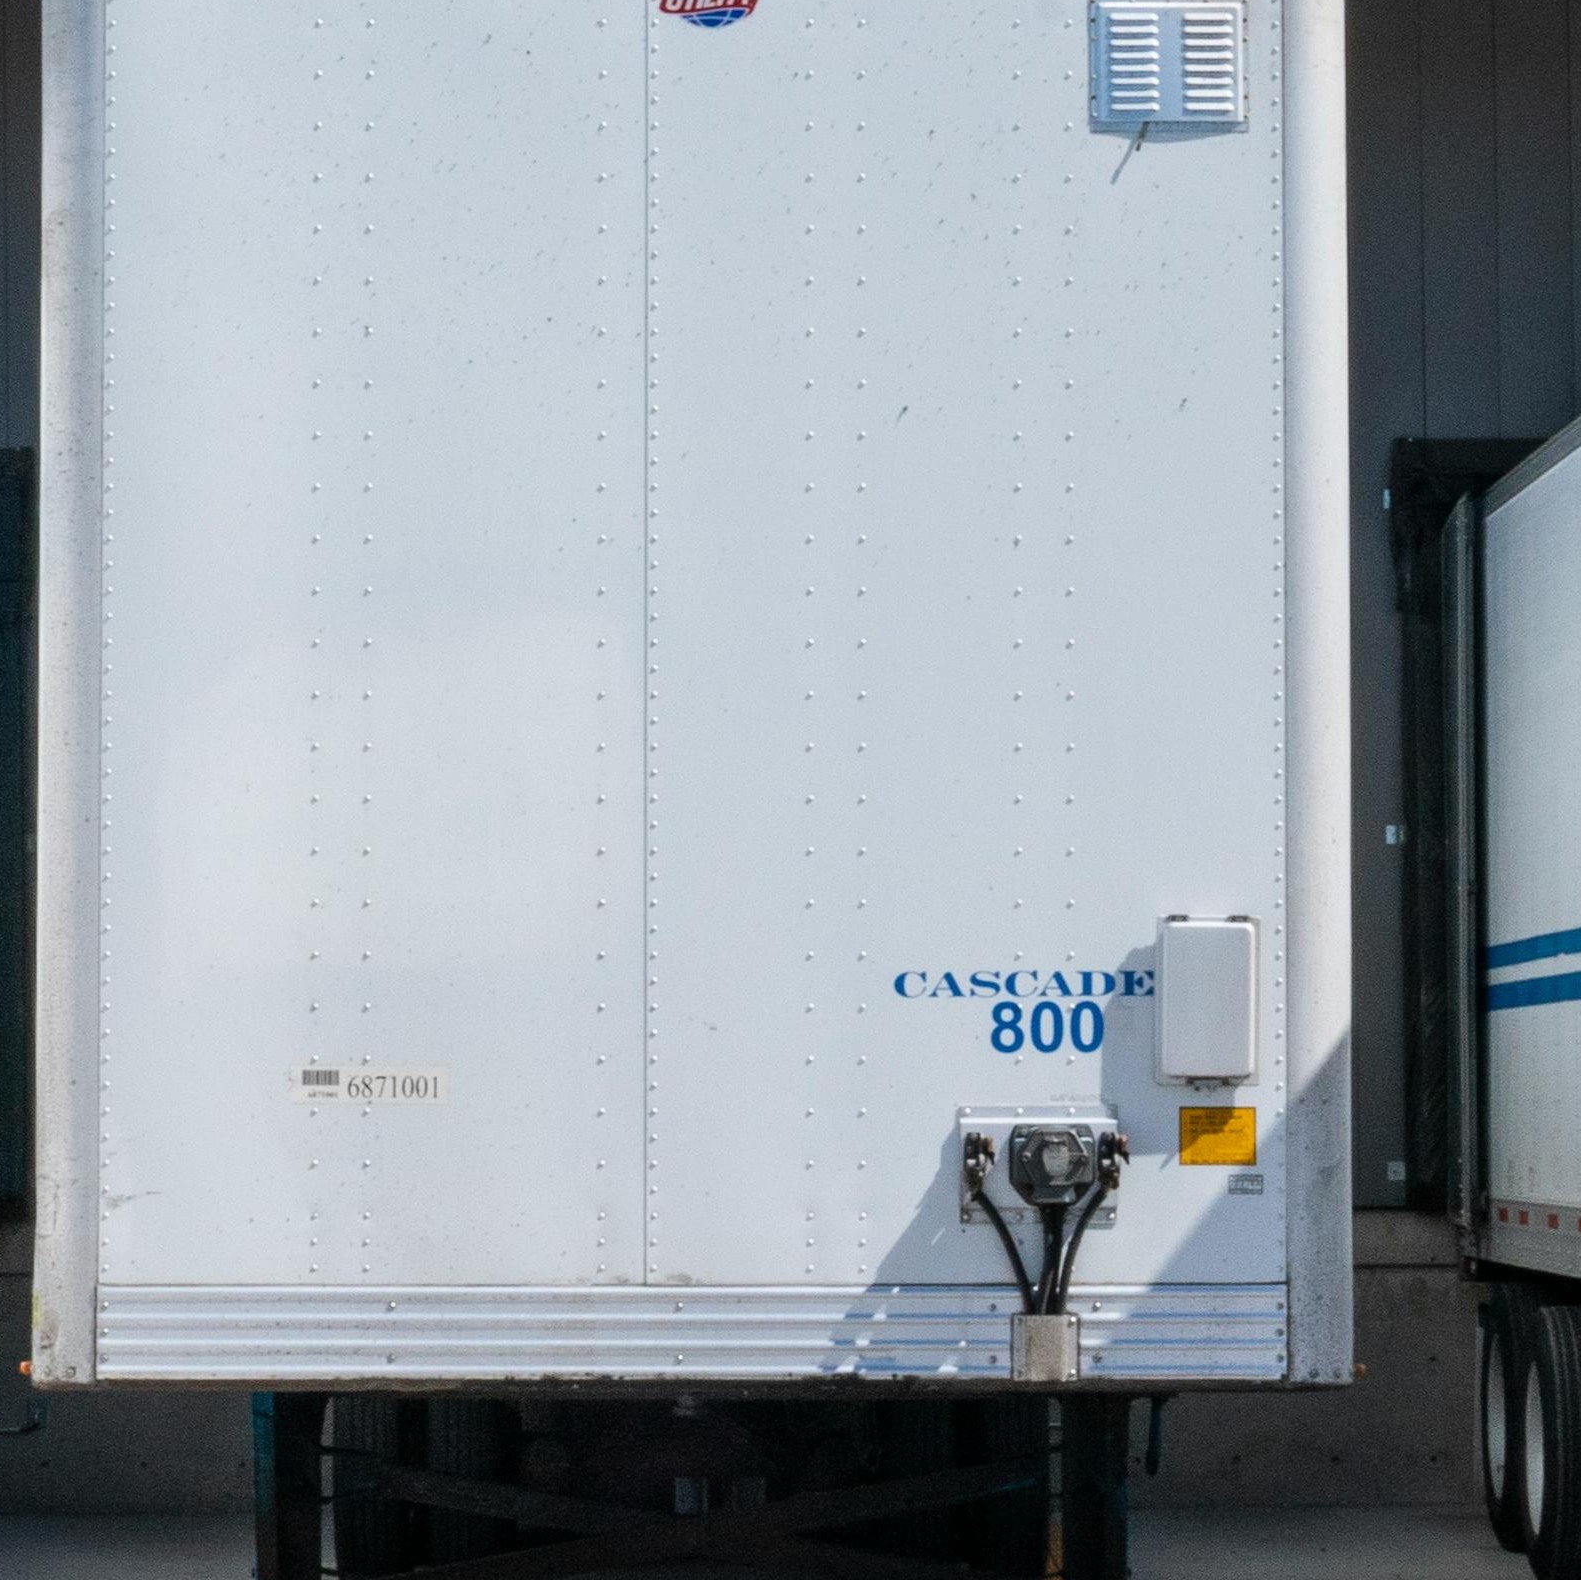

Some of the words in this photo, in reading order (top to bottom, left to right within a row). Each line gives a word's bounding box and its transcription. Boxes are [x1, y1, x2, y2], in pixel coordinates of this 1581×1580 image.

[894, 971, 1154, 998] CASCADE
[991, 1001, 1104, 1053] 800
[347, 1075, 438, 1098] 6871001
